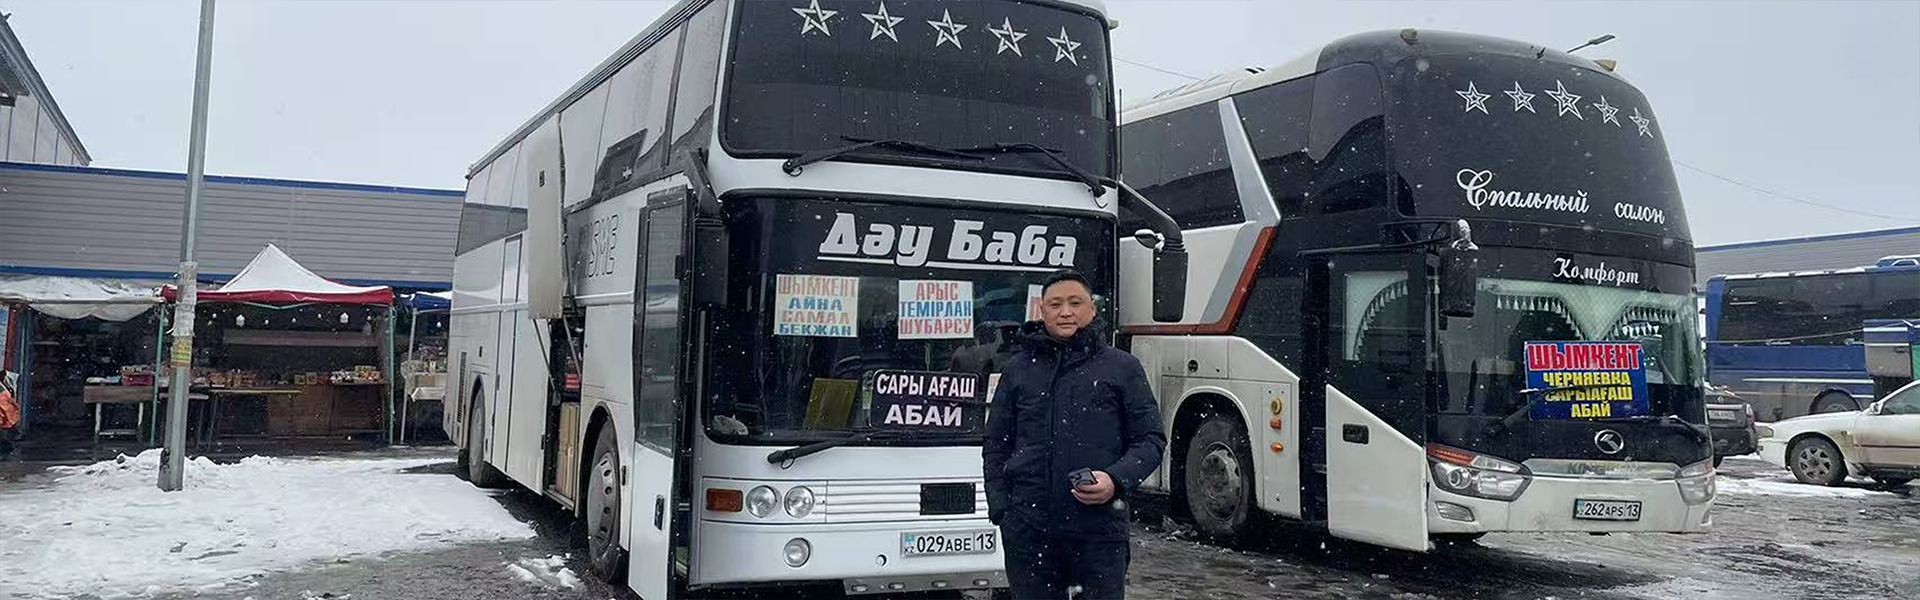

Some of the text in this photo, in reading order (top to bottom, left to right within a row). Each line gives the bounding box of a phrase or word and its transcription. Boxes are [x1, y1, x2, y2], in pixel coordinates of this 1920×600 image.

[1456, 168, 1666, 225] Спальный салон
[947, 219, 1078, 267] Баба
[1552, 256, 1641, 286] Комфорт
[778, 276, 857, 296] ШЫМКЕНТ
[916, 282, 958, 301] АРЫС
[789, 296, 843, 311] АЙНА
[900, 301, 972, 317] ТЕМІРЛАН
[782, 310, 850, 324] САМАЛ
[779, 323, 852, 336] БЕКЖАН
[1528, 343, 1641, 370] ШЫМКЕНТ
[876, 373, 976, 398] САРЫ АҒАШ
[1543, 372, 1632, 387] ЧЕРНЯЕВКА
[884, 401, 963, 427] АБАЙ
[1571, 400, 1612, 418] АБАЙ
[1626, 504, 1639, 517] 13
[917, 535, 972, 553] 029ABE
[976, 533, 995, 550] 13
